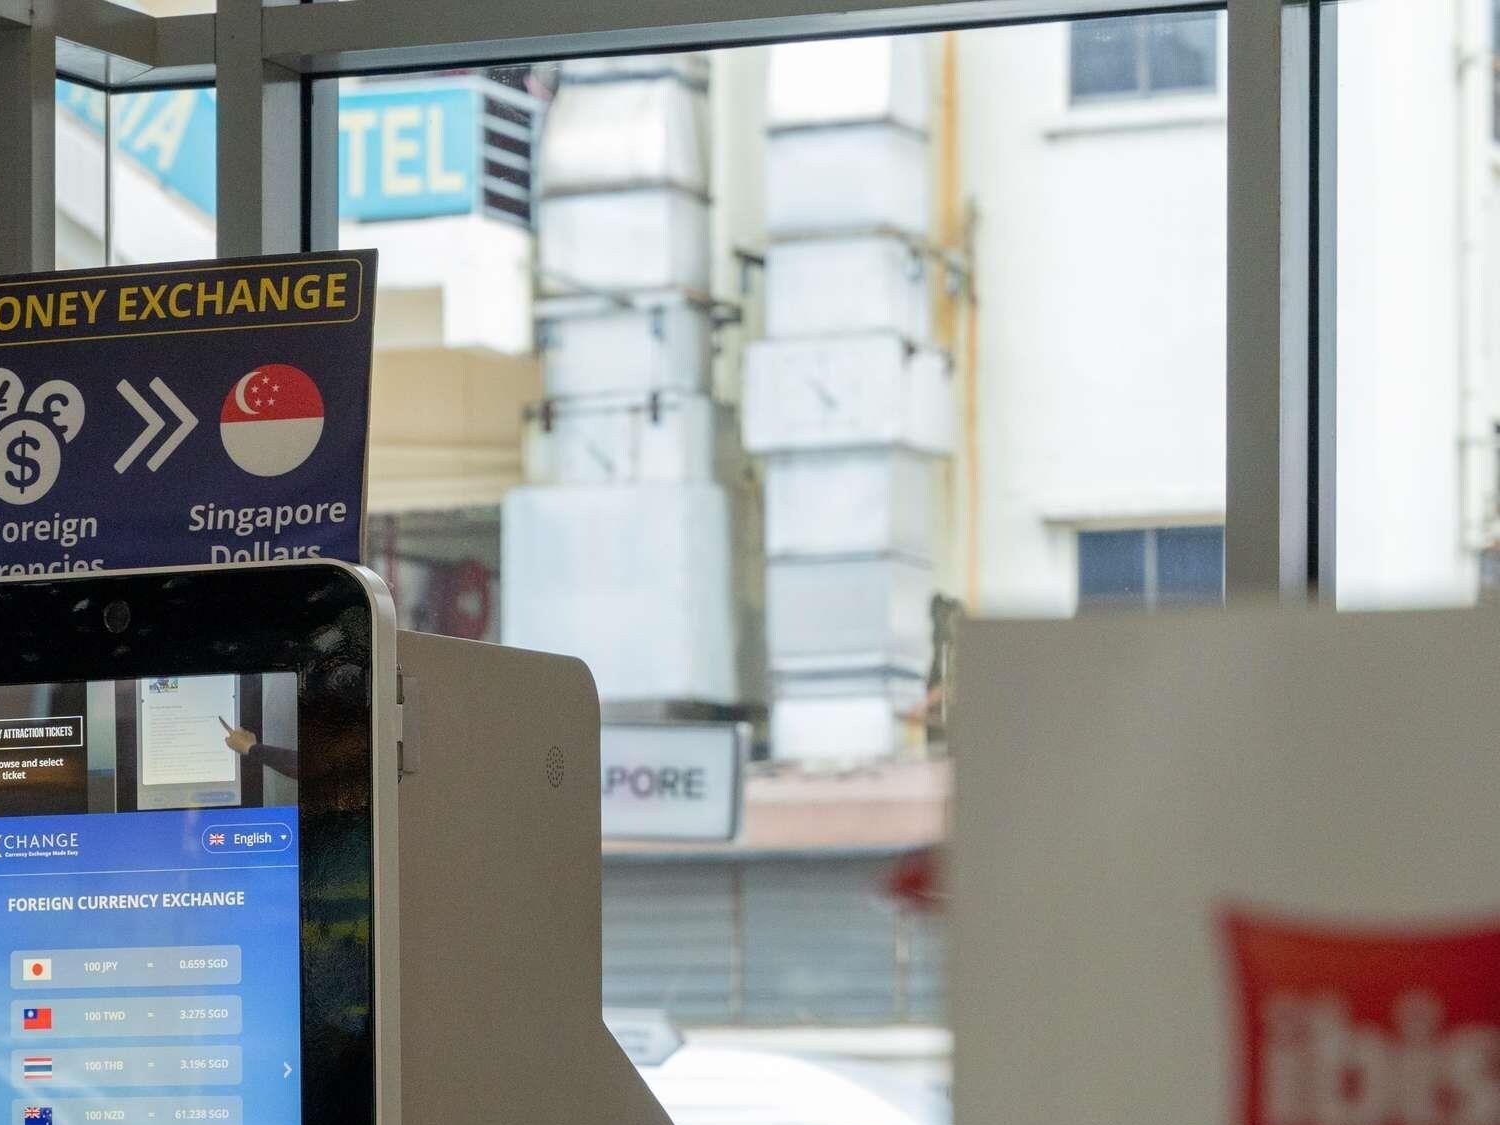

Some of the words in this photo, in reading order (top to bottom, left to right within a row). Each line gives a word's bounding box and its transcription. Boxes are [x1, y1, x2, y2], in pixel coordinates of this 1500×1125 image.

[339, 103, 466, 198] TEL
[117, 272, 348, 322] EXCHANGE
[189, 501, 347, 536] Singapore
[211, 541, 321, 565] Dollars
[3, 727, 44, 738] ATTRACTION
[45, 726, 73, 737] TICKETS
[22, 759, 37, 768] and
[39, 758, 64, 767] select
[2, 770, 27, 780] ticket
[602, 766, 707, 800] PORE
[233, 831, 272, 846] English
[8, 897, 74, 912] FOREIGN
[77, 893, 159, 910] CURRENCY
[162, 891, 245, 907] EXCHANGE
[84, 962, 101, 972] 100
[207, 959, 228, 968] SGD
[84, 1012, 101, 1021] 100
[208, 1009, 228, 1019] SGD
[85, 1061, 101, 1071] 100
[208, 1059, 228, 1069] SGD
[85, 1111, 102, 1120] 100
[208, 1109, 229, 1119] SGD
